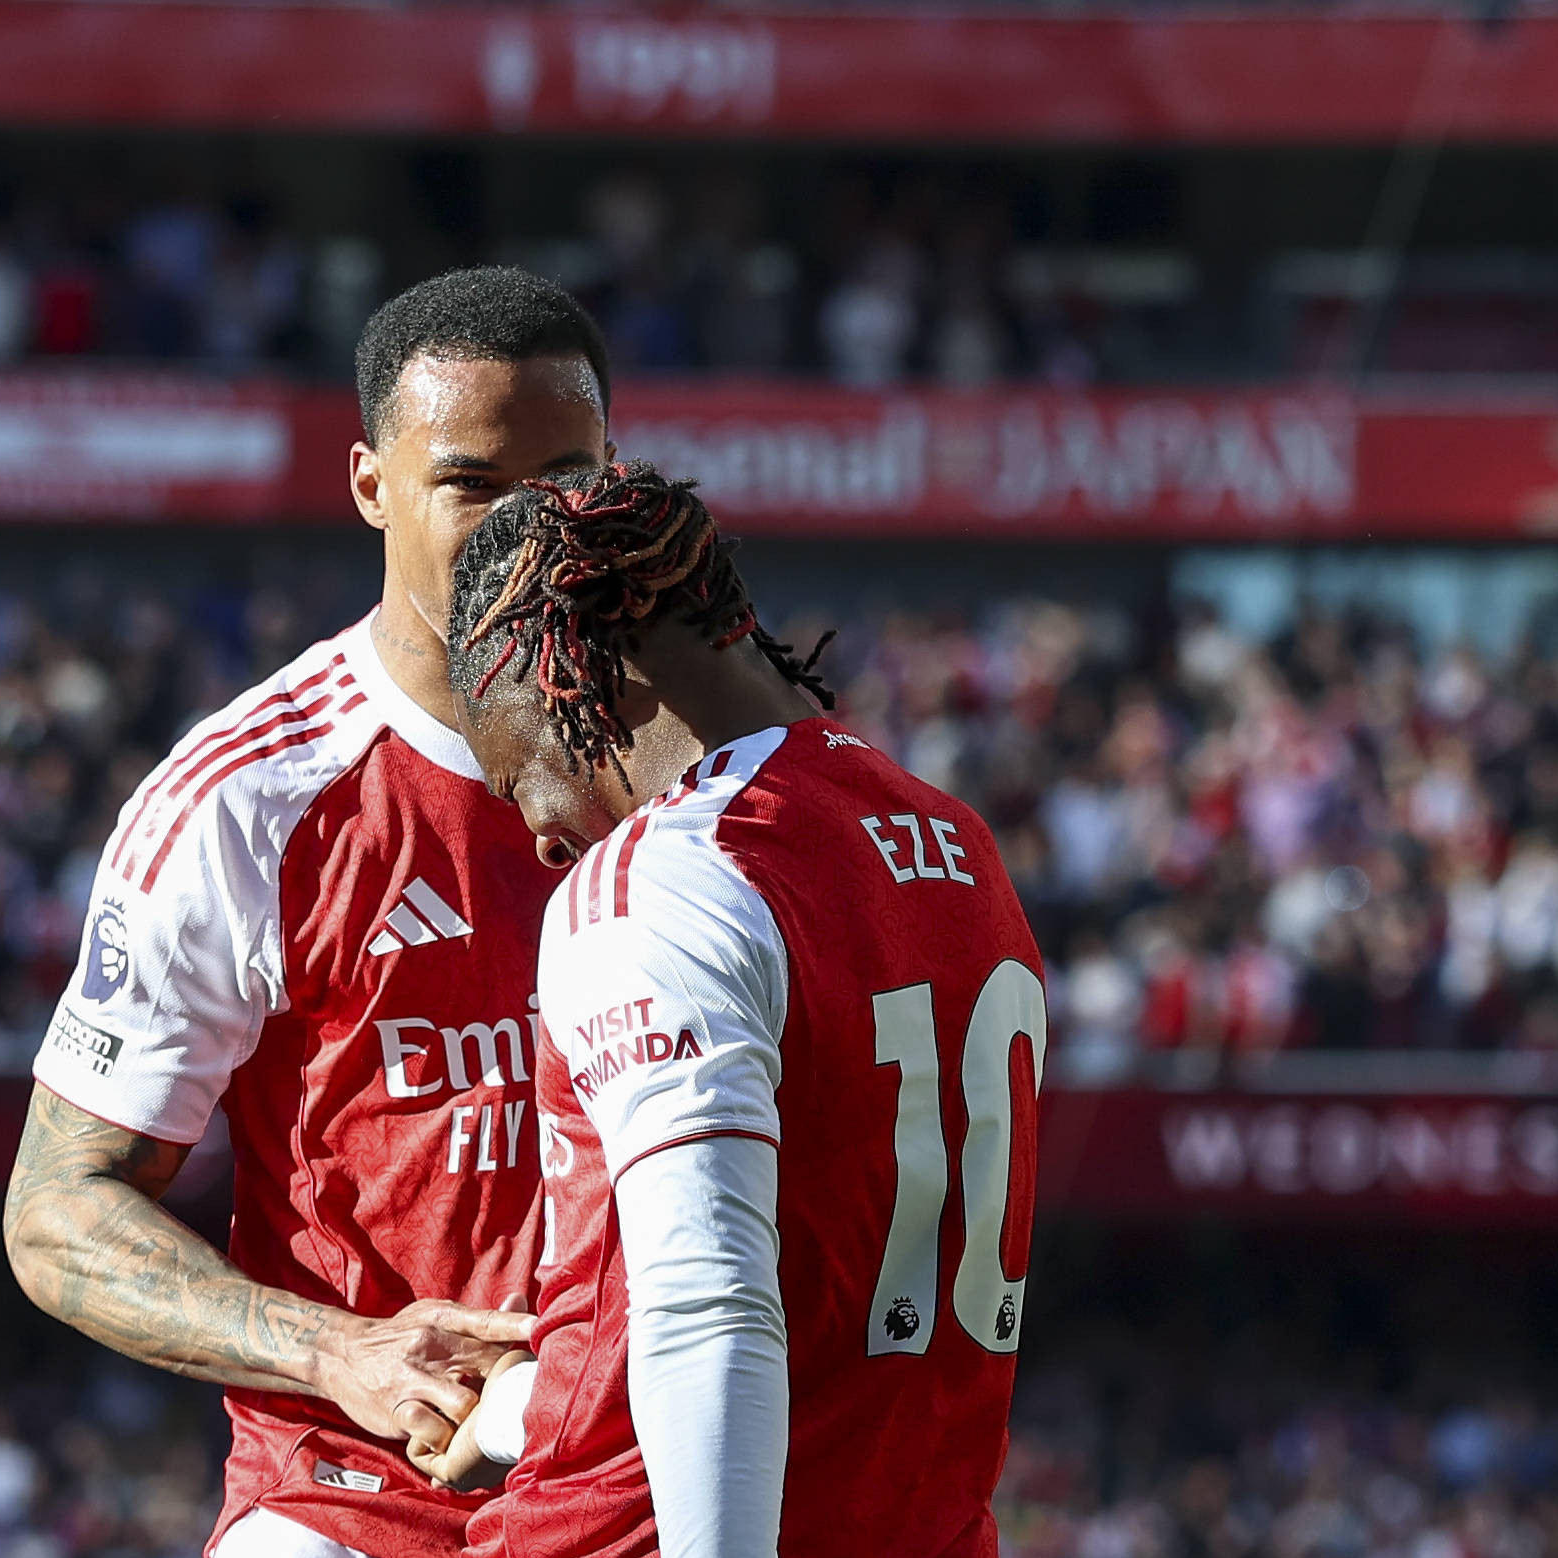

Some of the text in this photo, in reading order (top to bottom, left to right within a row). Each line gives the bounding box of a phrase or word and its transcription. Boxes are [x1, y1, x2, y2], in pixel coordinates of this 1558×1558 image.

[613, 396, 1353, 516] rsenal JAPAN
[859, 813, 976, 887] EZE
[576, 998, 653, 1049] VISIT
[572, 1029, 704, 1102] RWANDA
[447, 1098, 527, 1175] FLY
[866, 957, 1048, 1357] 10
